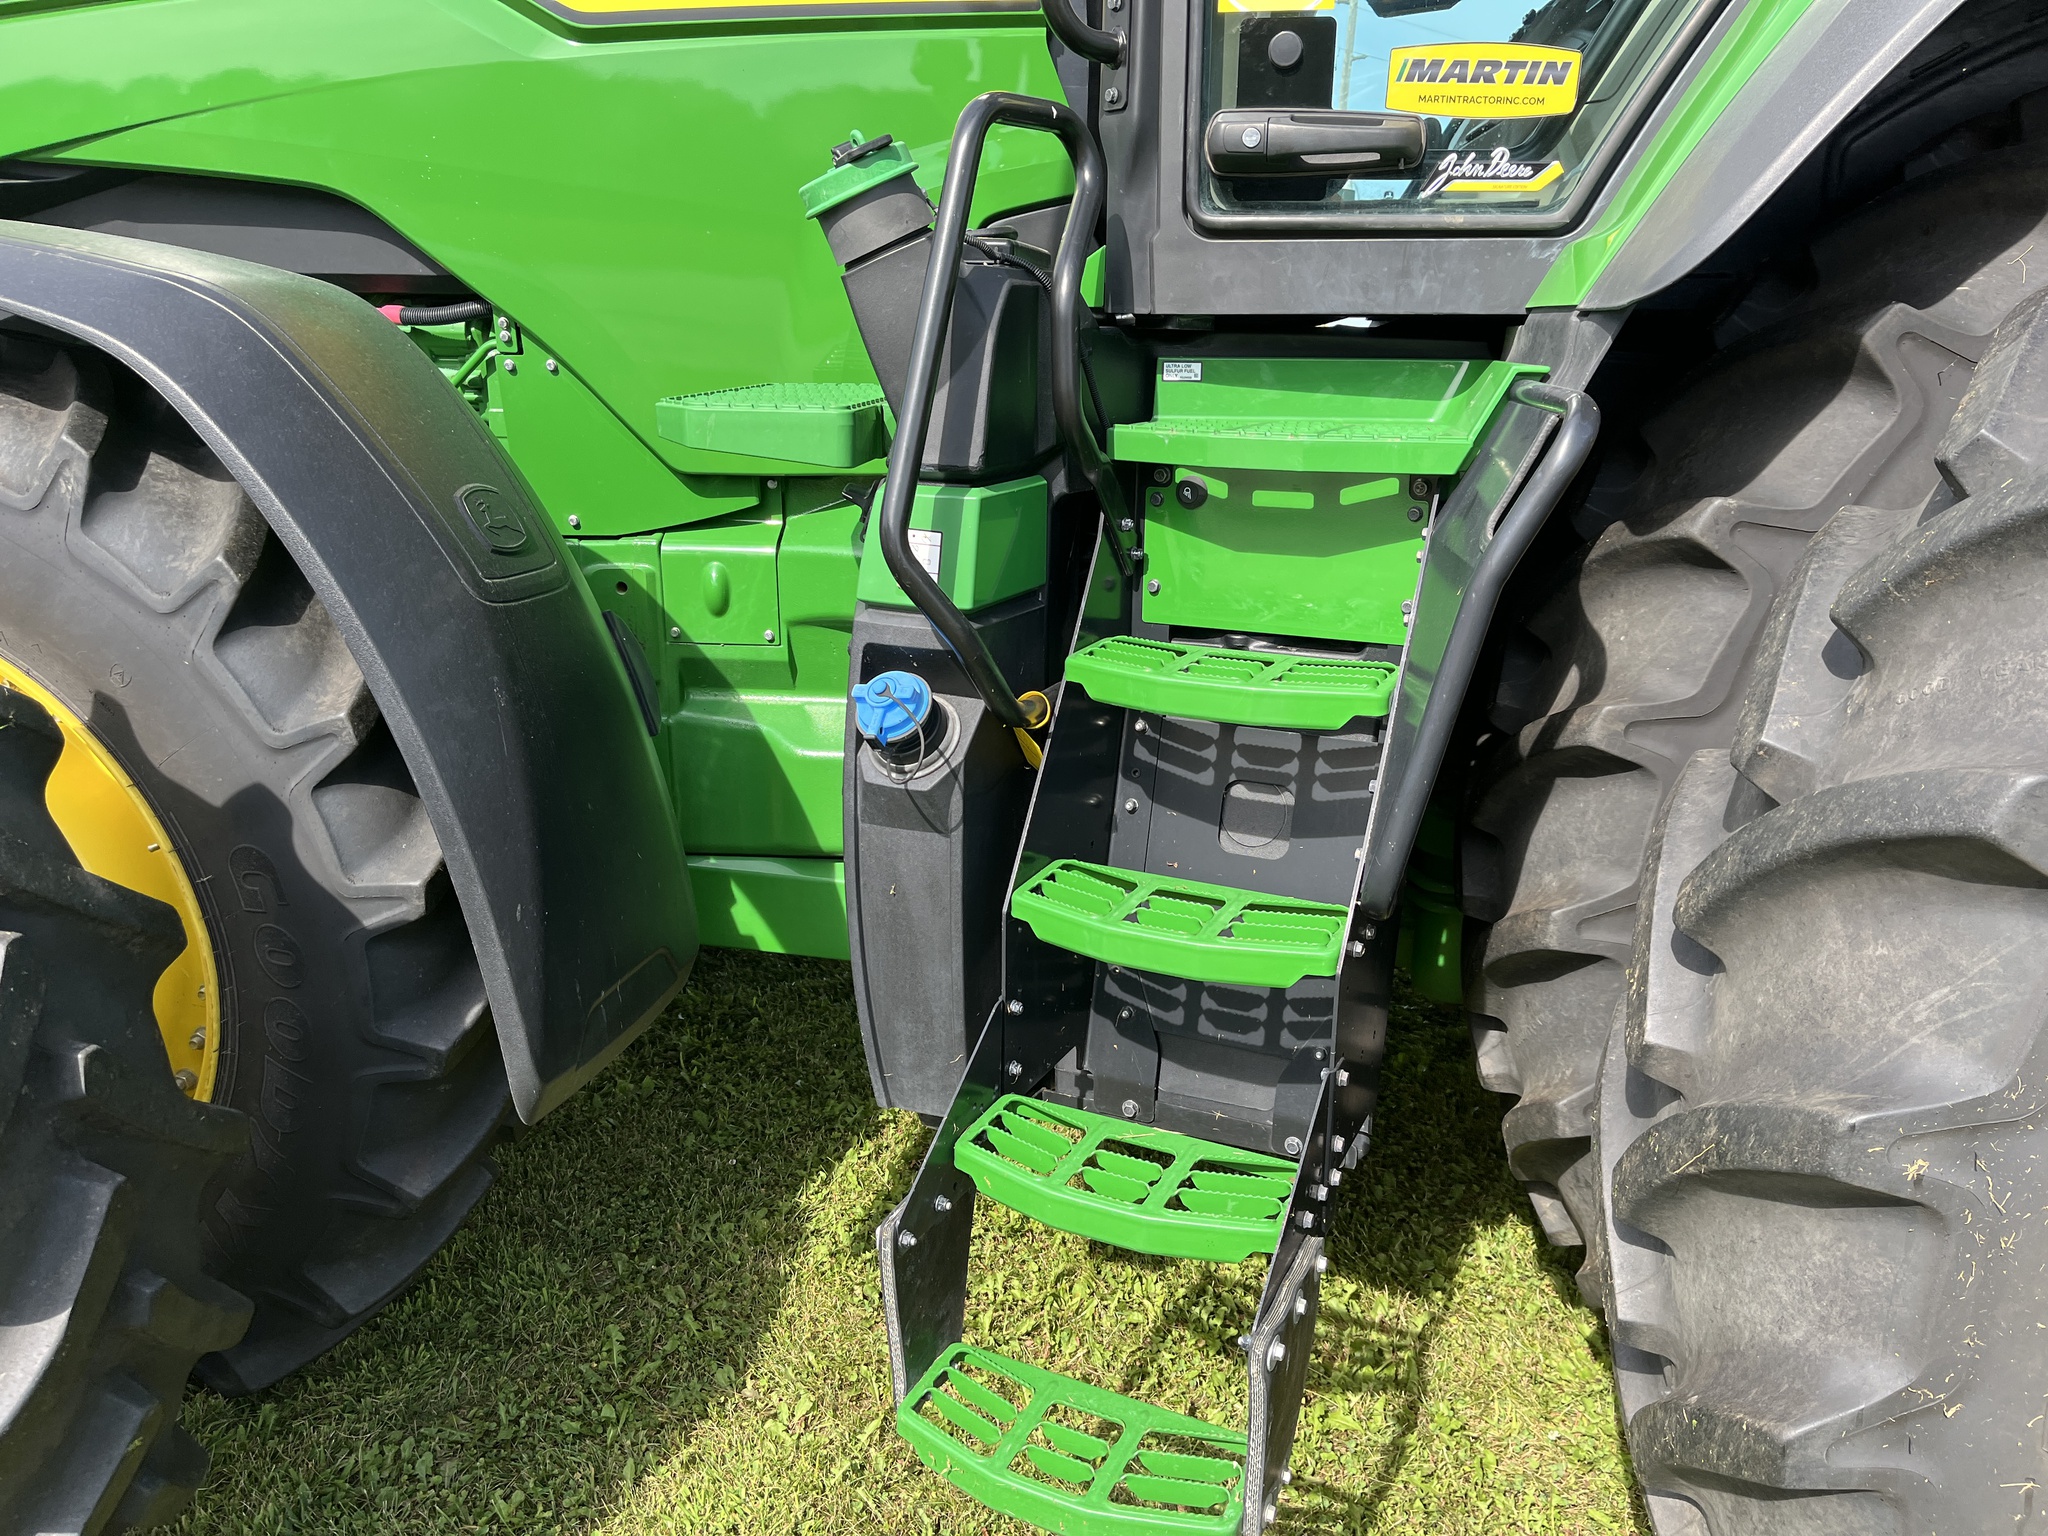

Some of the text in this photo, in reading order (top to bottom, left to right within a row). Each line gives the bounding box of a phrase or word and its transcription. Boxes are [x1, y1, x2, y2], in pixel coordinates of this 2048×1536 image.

[1404, 58, 1574, 86] MARTIN
[1417, 94, 1546, 106] MARTINTRACTORINC.COM
[1420, 146, 1534, 199] John Deere
